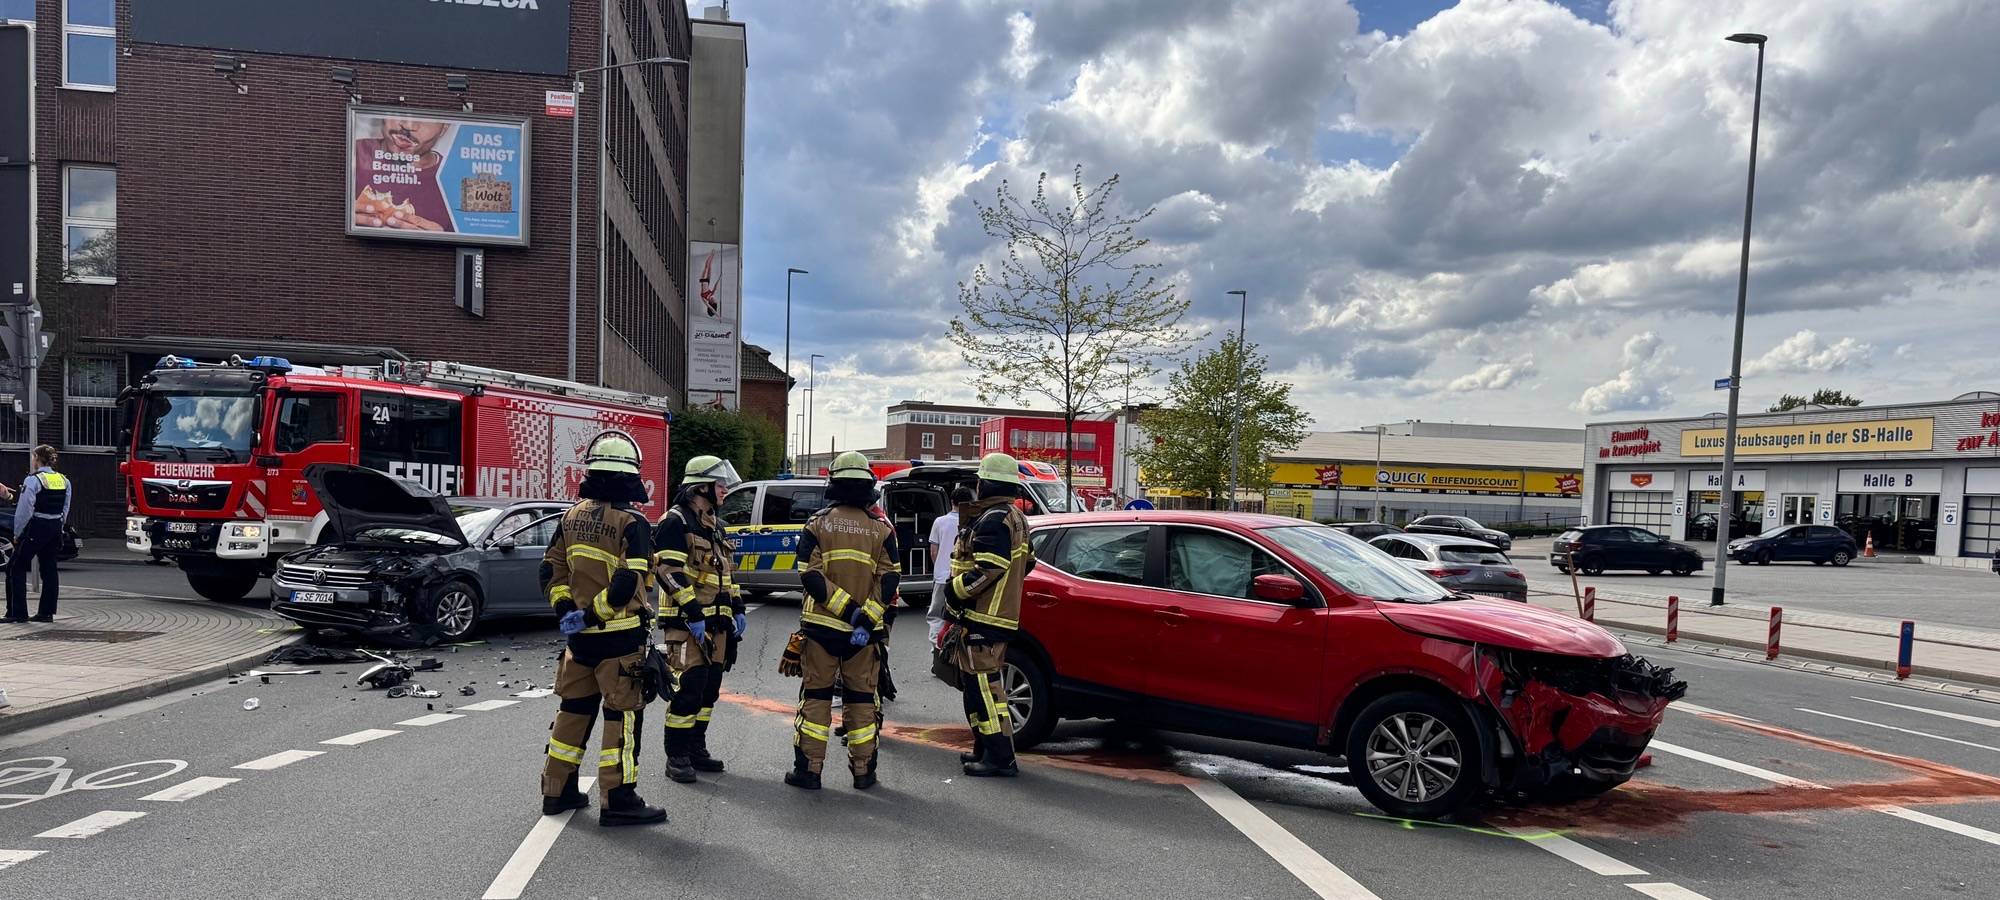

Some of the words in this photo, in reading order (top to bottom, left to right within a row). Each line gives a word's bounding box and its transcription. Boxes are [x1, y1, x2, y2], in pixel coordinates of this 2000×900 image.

[473, 133, 502, 146] DAS
[374, 149, 421, 162] Bestes
[460, 146, 515, 162] BRINGT
[372, 161, 422, 173] Bauch-
[471, 161, 503, 175] NUR
[372, 174, 421, 185] gefühl.
[475, 190, 503, 202] Wolt
[372, 406, 391, 422] 2A
[1611, 427, 1649, 443] Einmalig
[1694, 435, 1725, 449] Luxus
[1809, 430, 1822, 445] in
[1826, 428, 1848, 444] der
[1852, 426, 1914, 443] SB-Halle
[1599, 446, 1610, 458] im
[1611, 440, 1662, 457] Ruhrgebiet
[1957, 435, 1985, 451] zur
[154, 463, 215, 478] FEUERWEHR
[266, 468, 279, 476] 2/73
[1377, 470, 1427, 485] QUICK
[1431, 475, 1519, 488] REIFENDISCOUNT
[1738, 474, 1745, 486] A
[1863, 474, 1895, 487] Halle
[1905, 474, 1913, 487] B
[833, 517, 860, 528] ESSEN
[576, 531, 600, 545] ESSEN
